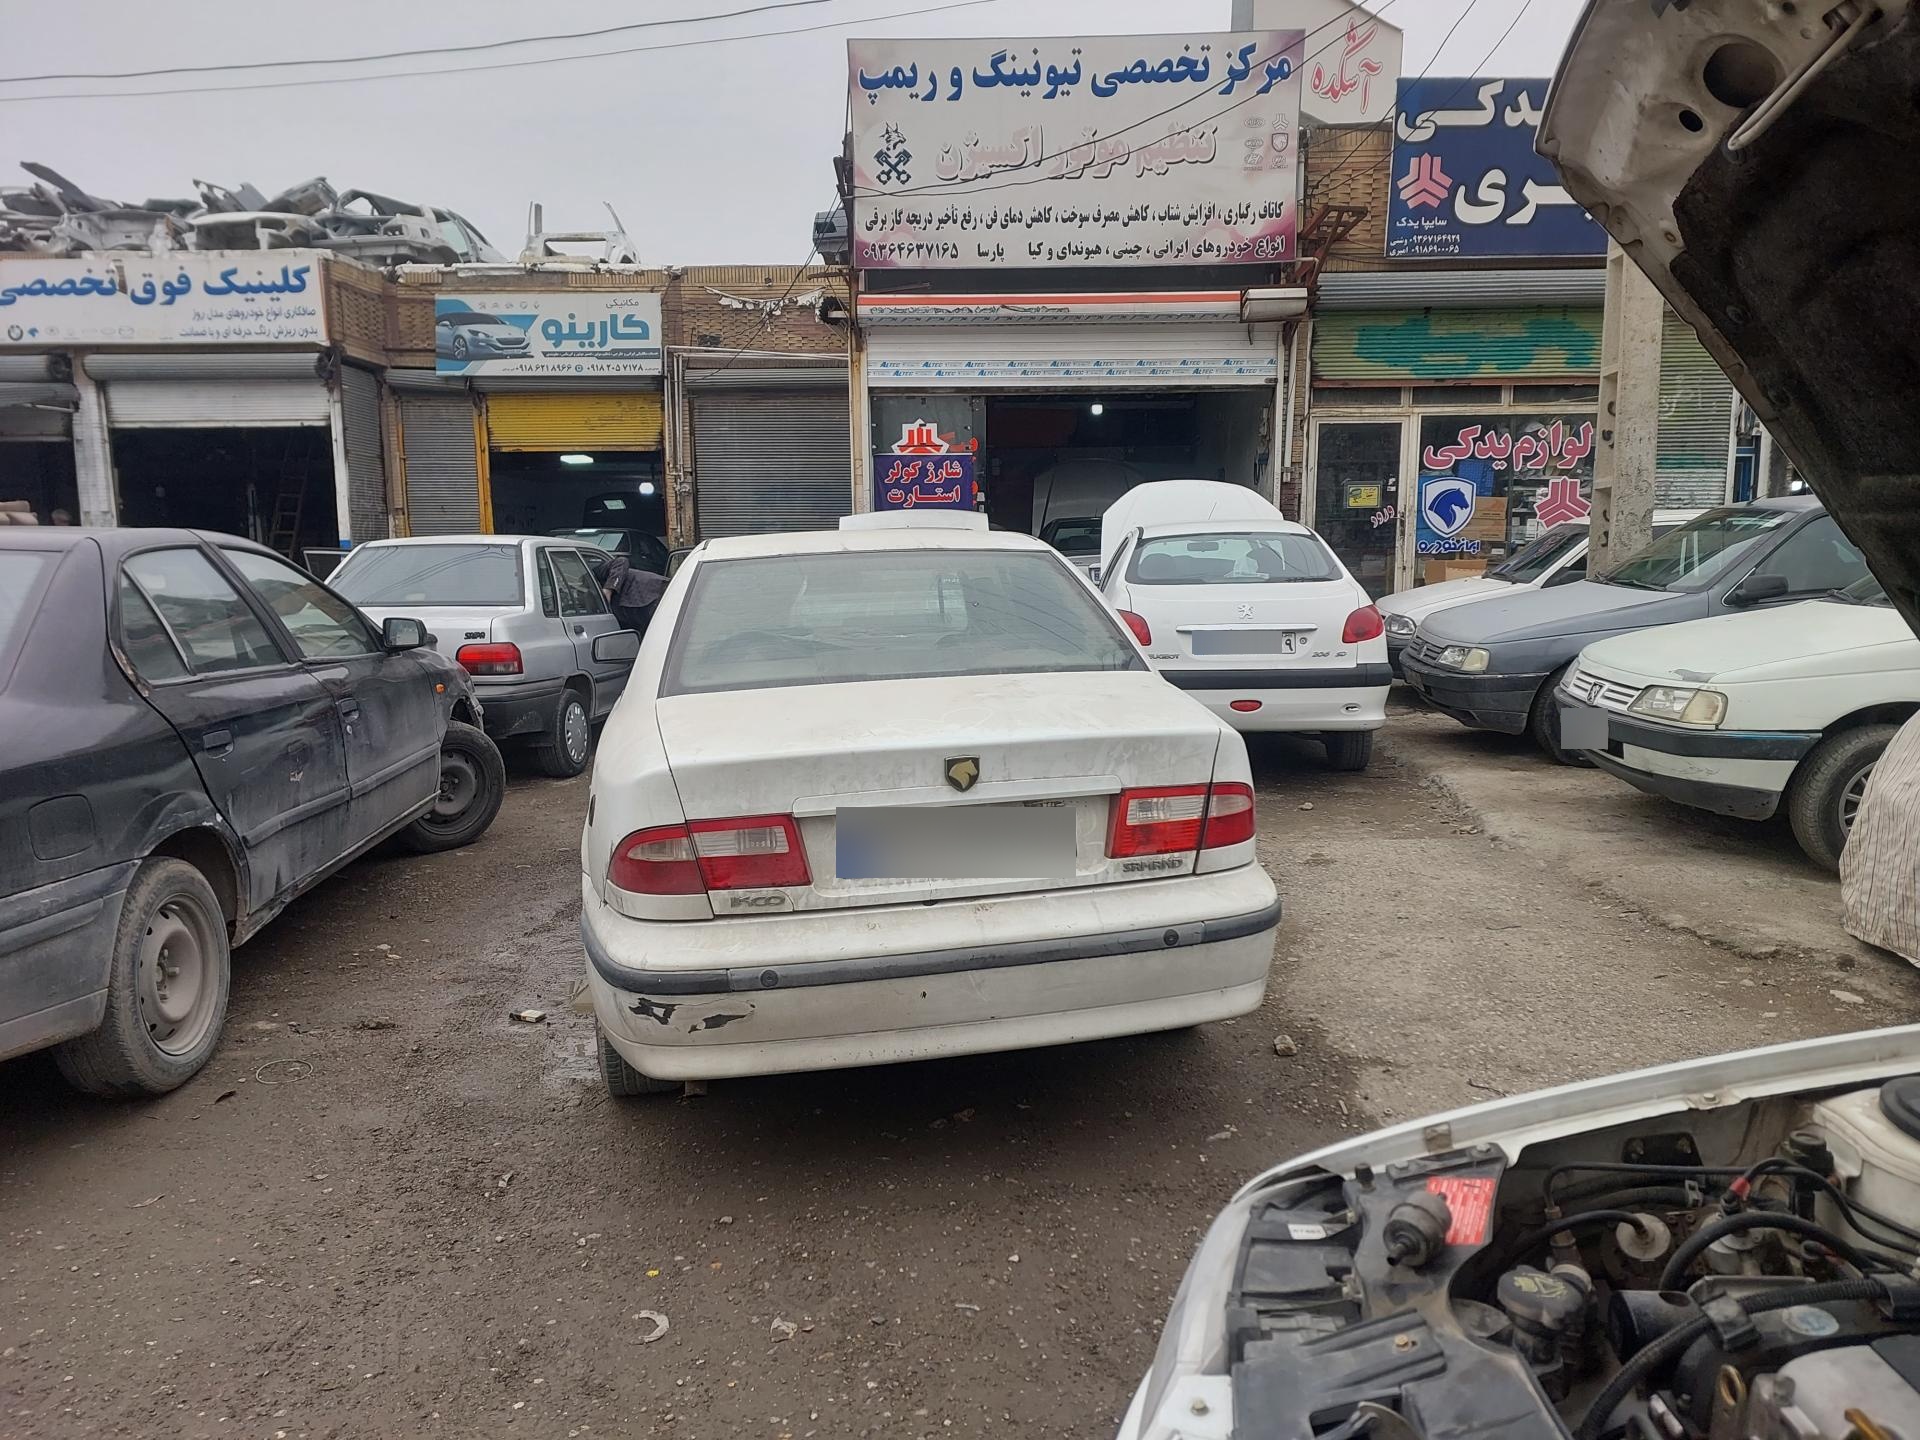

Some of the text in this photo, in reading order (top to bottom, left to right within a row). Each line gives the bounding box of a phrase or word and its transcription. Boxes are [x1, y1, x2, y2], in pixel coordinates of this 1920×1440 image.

[859, 42, 1292, 105] مرکز تخصصی تیونینگ و ریمپ
[1048, 127, 1130, 178] موتور
[1135, 122, 1218, 177] تنظیم
[865, 207, 887, 231] برقی
[890, 208, 904, 231] گاز
[906, 211, 933, 231] دریچه
[960, 206, 977, 230] رفع
[985, 205, 998, 229] فن
[1000, 206, 1023, 229] دمای
[1025, 206, 1052, 229] کاهش
[1061, 205, 1090, 228] سوخت
[1092, 204, 1120, 228] مصرف
[1122, 204, 1149, 227] کاهش
[1158, 203, 1181, 226] شتاب
[1183, 201, 1216, 227] افزایش
[1396, 216, 1447, 231] سایپا یدک
[863, 242, 1004, 262] پارسا ۰۹۳۶۴۶۳۷۱۶۵
[1028, 241, 1043, 260] کیا
[1046, 247, 1053, 260] و
[1057, 241, 1101, 260] هیوندای
[1113, 242, 1142, 260] چینی
[1154, 238, 1189, 259] ایرانی
[1192, 237, 1252, 258] خودروهای
[1255, 237, 1284, 257] انواع
[0, 265, 310, 306] کلینیک فوق تخصصی
[605, 298, 639, 309] مکانیکی
[541, 312, 650, 348] کارینو
[1423, 420, 1593, 471] لوازم یدکی
[884, 460, 962, 483] شارژ کولر
[887, 485, 960, 508] استارت
[1370, 505, 1395, 529] ورود
[464, 631, 486, 640] SAIPA
[1284, 638, 1293, 652] ۹
[1123, 858, 1183, 873] SAMAND
